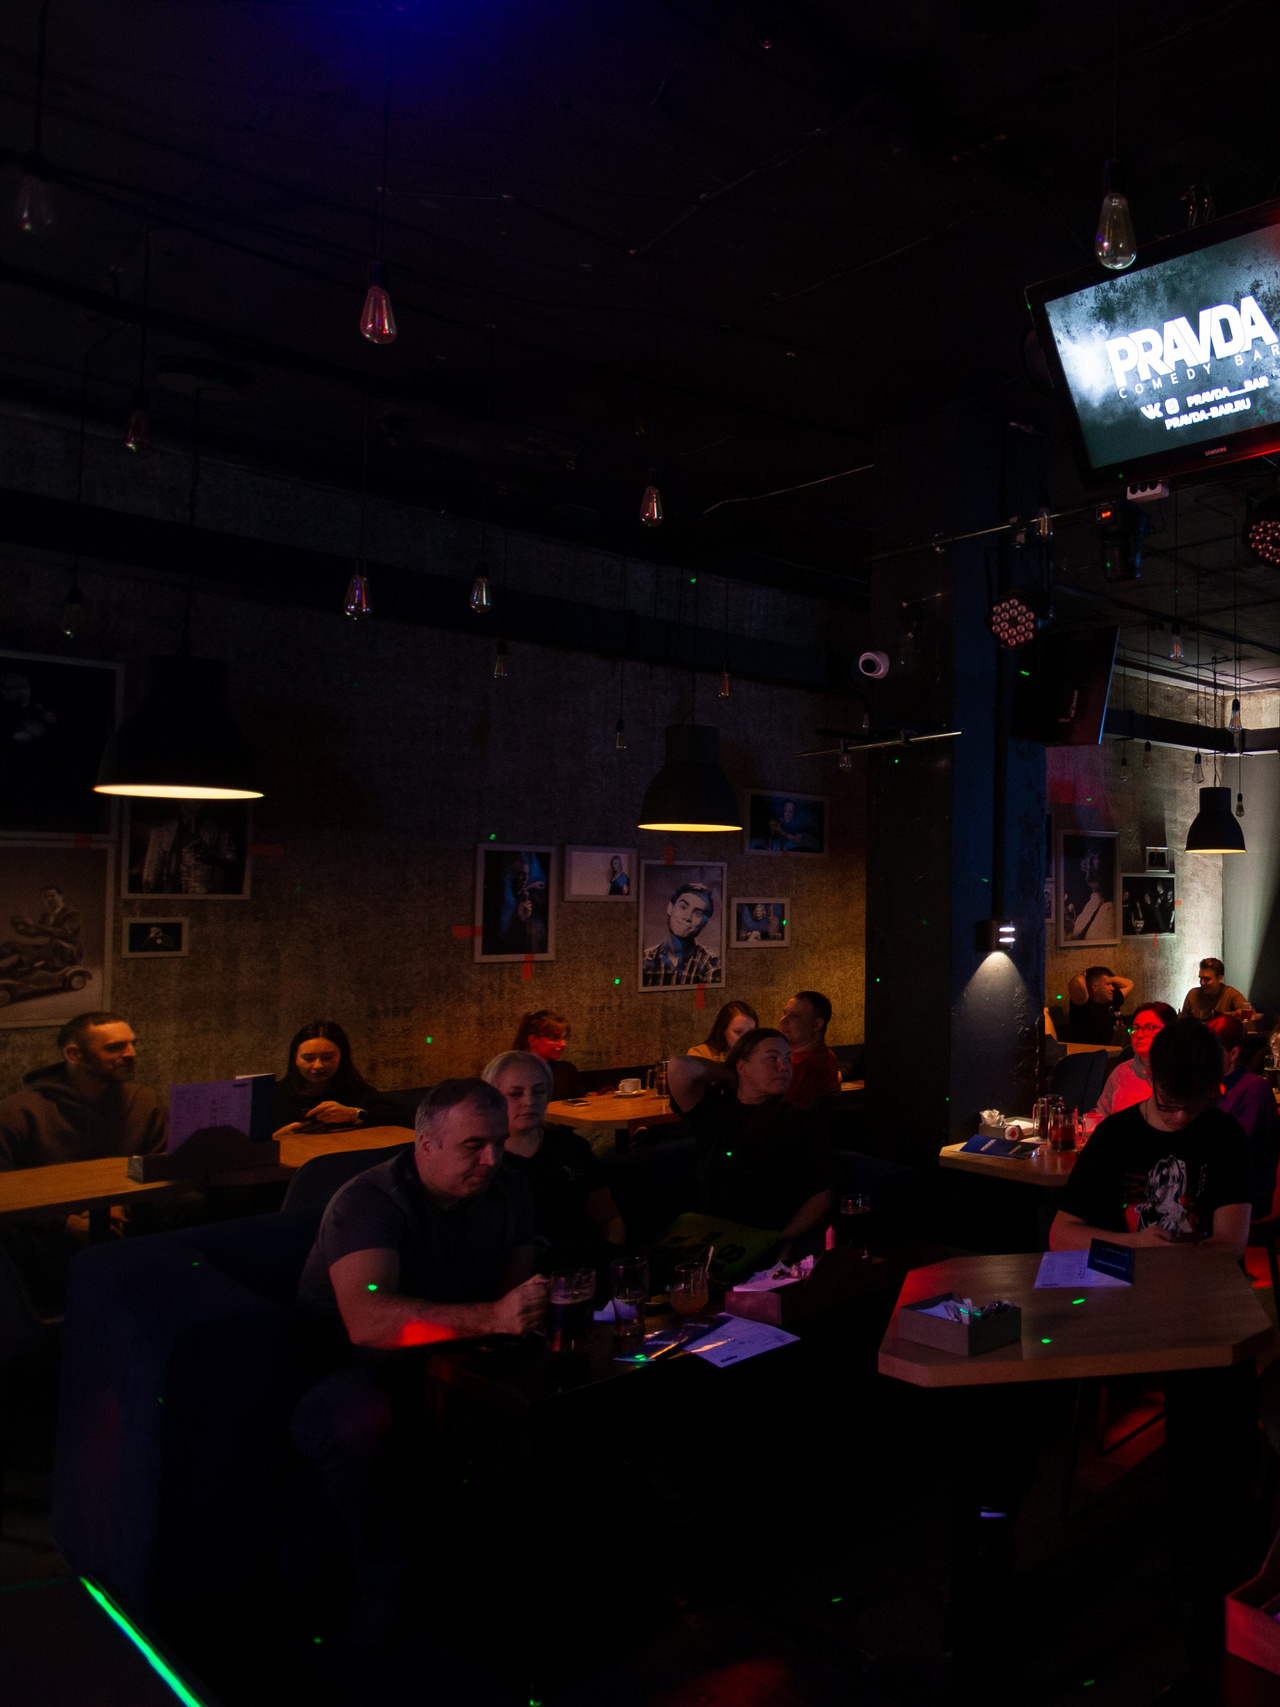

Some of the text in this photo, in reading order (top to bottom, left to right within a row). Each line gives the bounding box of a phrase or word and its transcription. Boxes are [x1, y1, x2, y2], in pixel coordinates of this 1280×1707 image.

[1106, 296, 1278, 387] PRAVDA
[1119, 344, 1280, 399] COMEDY BAR
